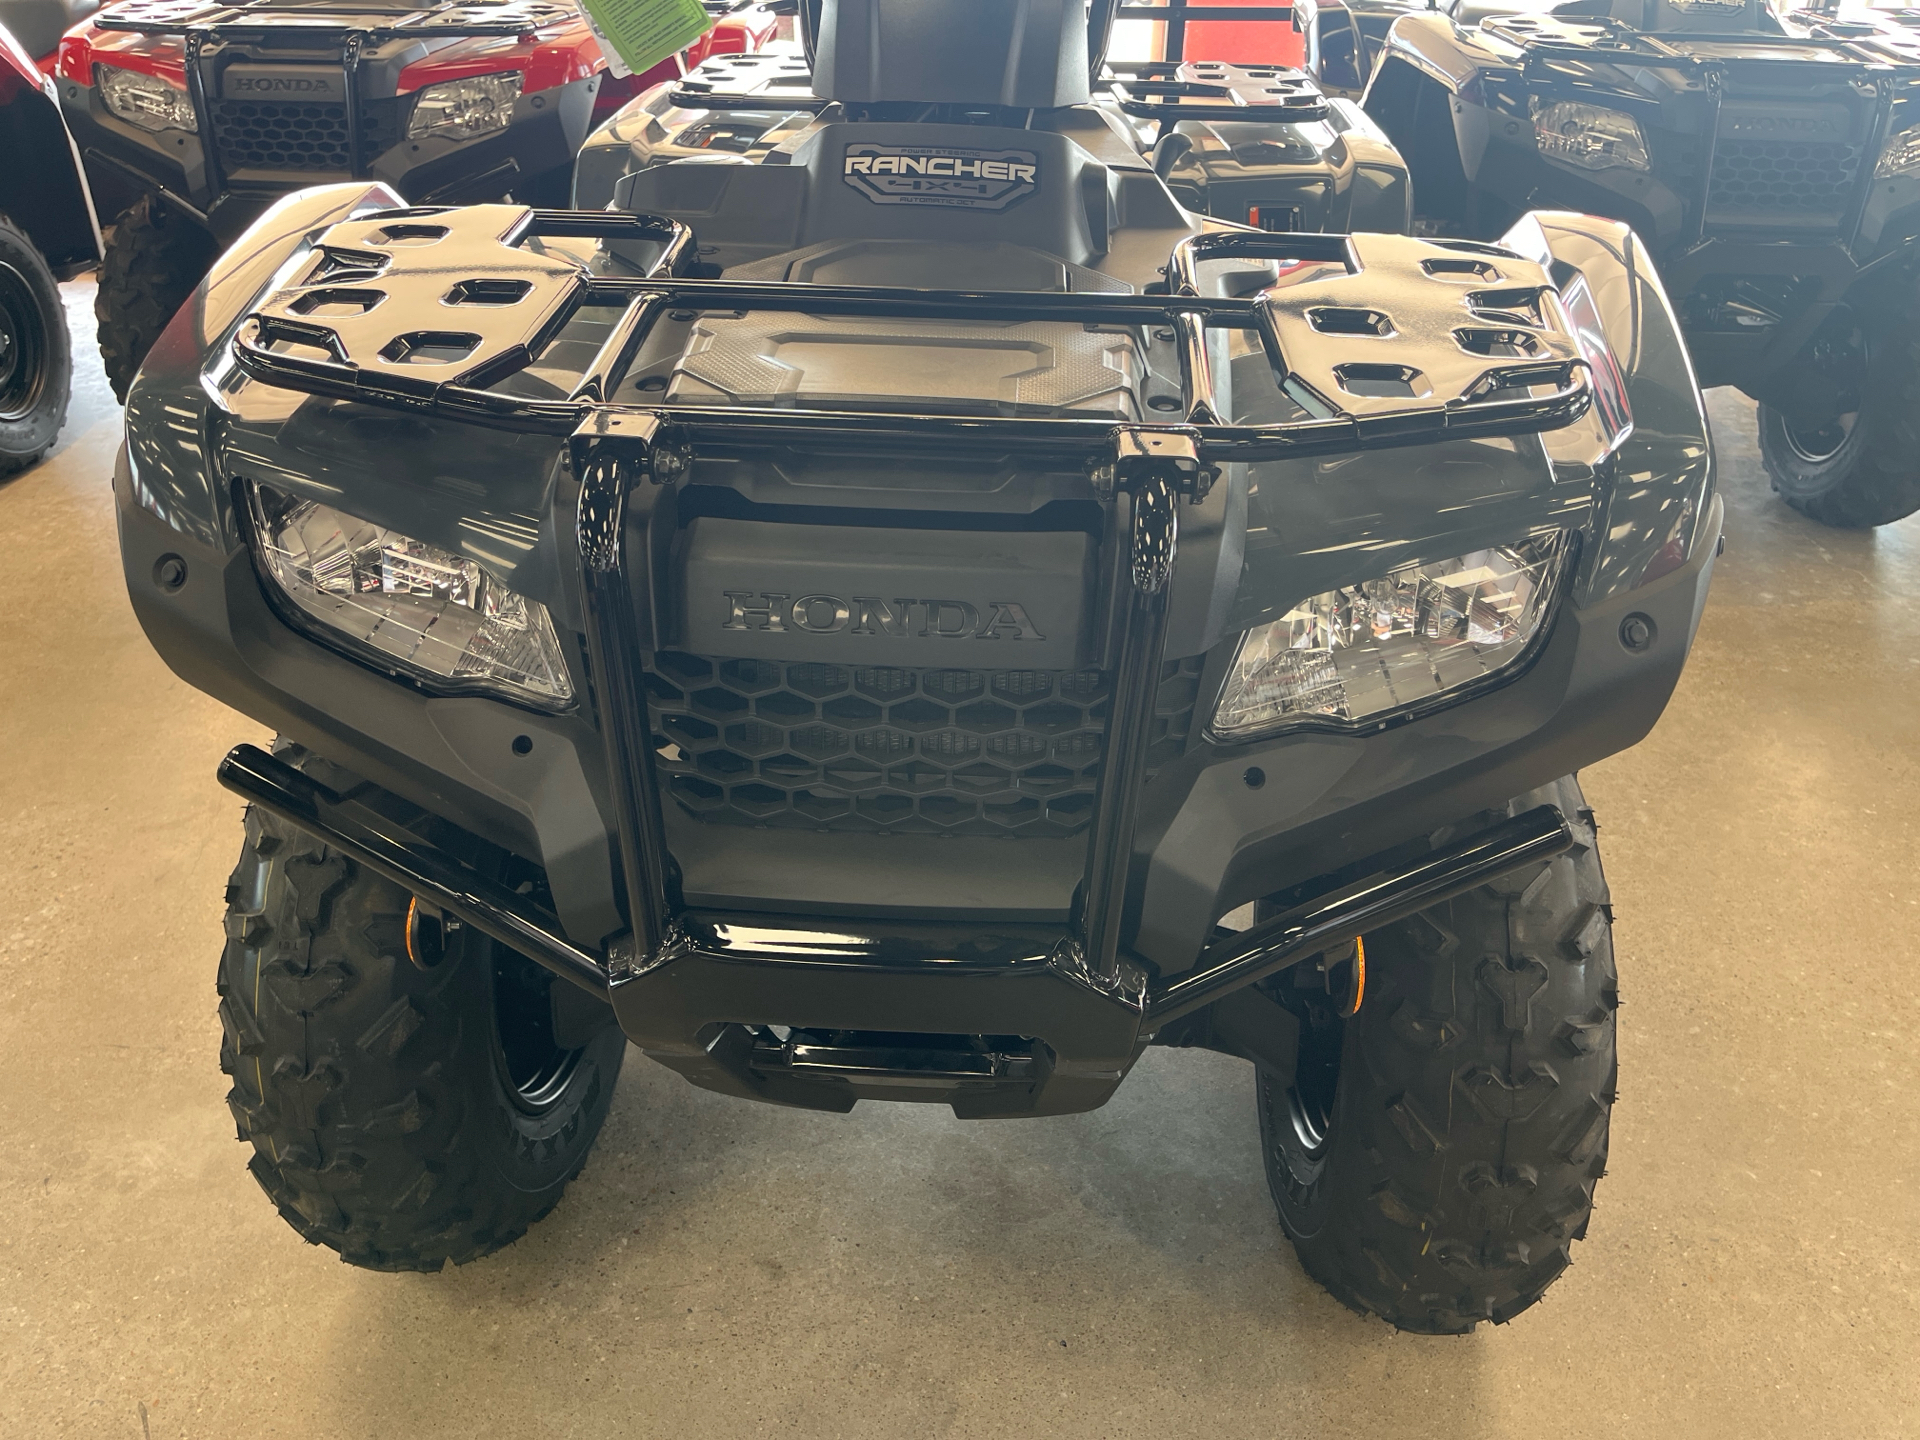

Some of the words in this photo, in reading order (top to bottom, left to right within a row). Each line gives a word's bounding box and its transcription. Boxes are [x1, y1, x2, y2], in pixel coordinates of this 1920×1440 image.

[235, 78, 334, 92] HONDA
[1732, 116, 1840, 132] HONDA
[845, 156, 1036, 183] RANCHER
[900, 196, 955, 205] AUTOMATIC
[722, 591, 1046, 640] HONDA
